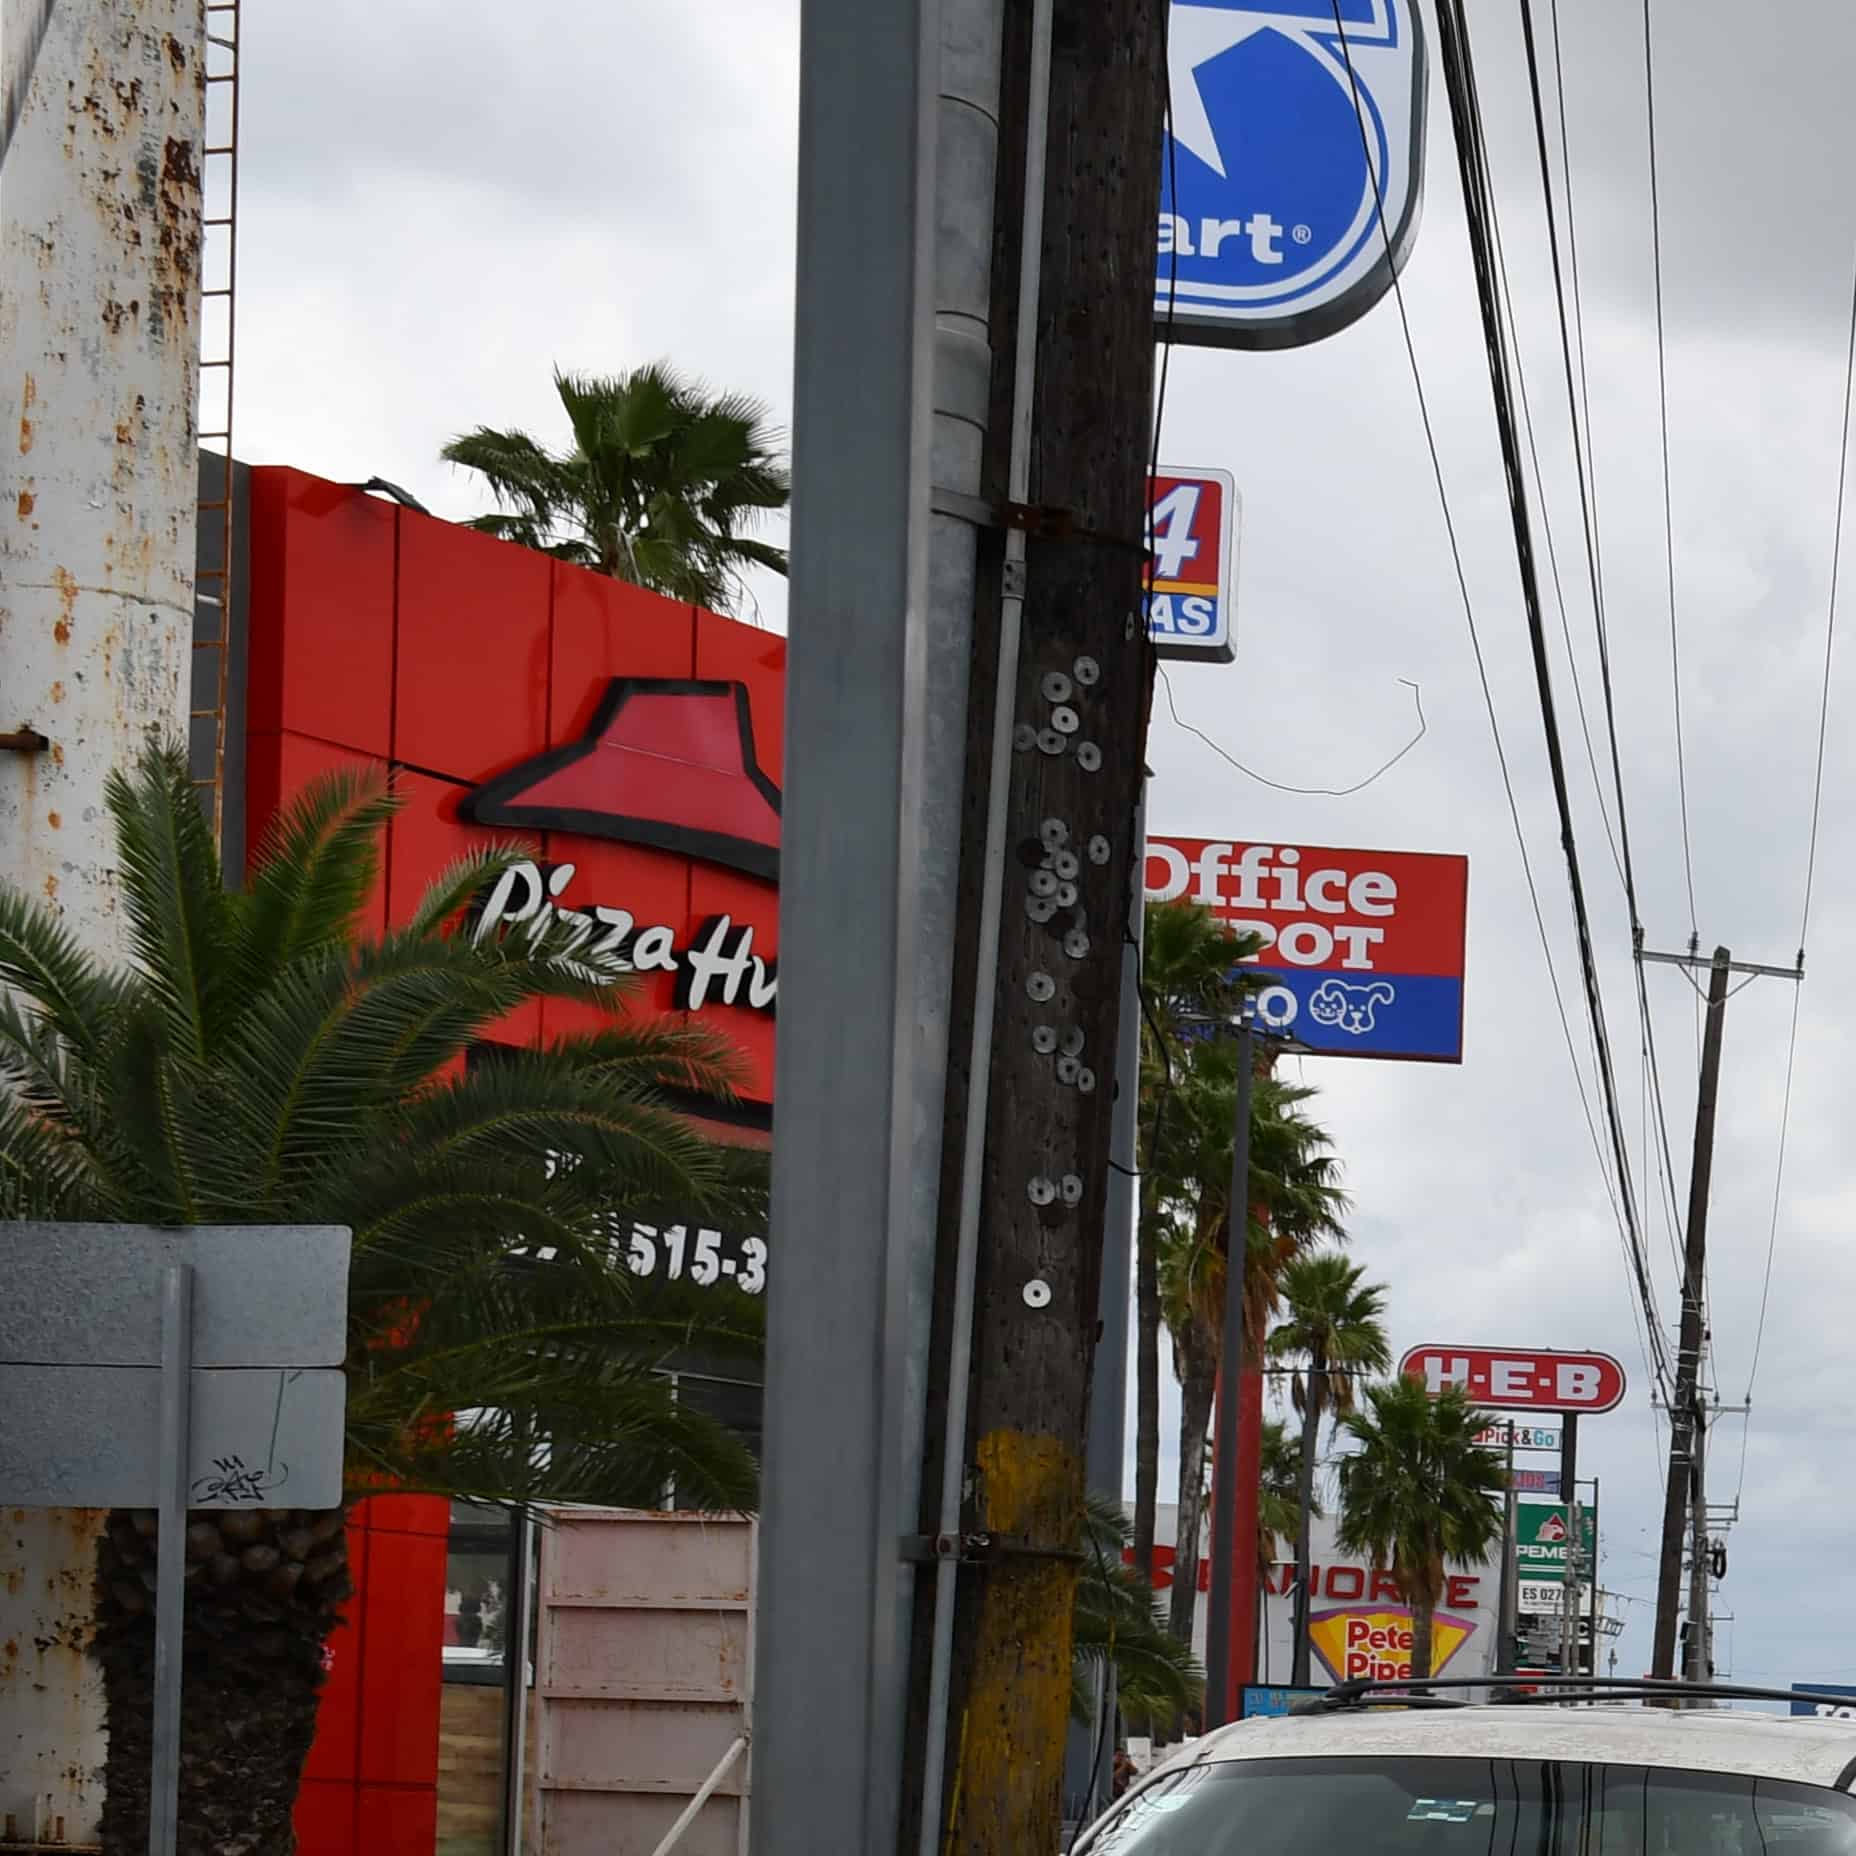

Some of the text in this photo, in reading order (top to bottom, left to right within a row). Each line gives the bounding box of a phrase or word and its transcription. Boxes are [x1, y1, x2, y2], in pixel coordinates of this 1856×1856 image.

[1144, 843, 1397, 916] Office
[1424, 1356, 1601, 1401] H-E-B
[1346, 1619, 1414, 1651] Pete
